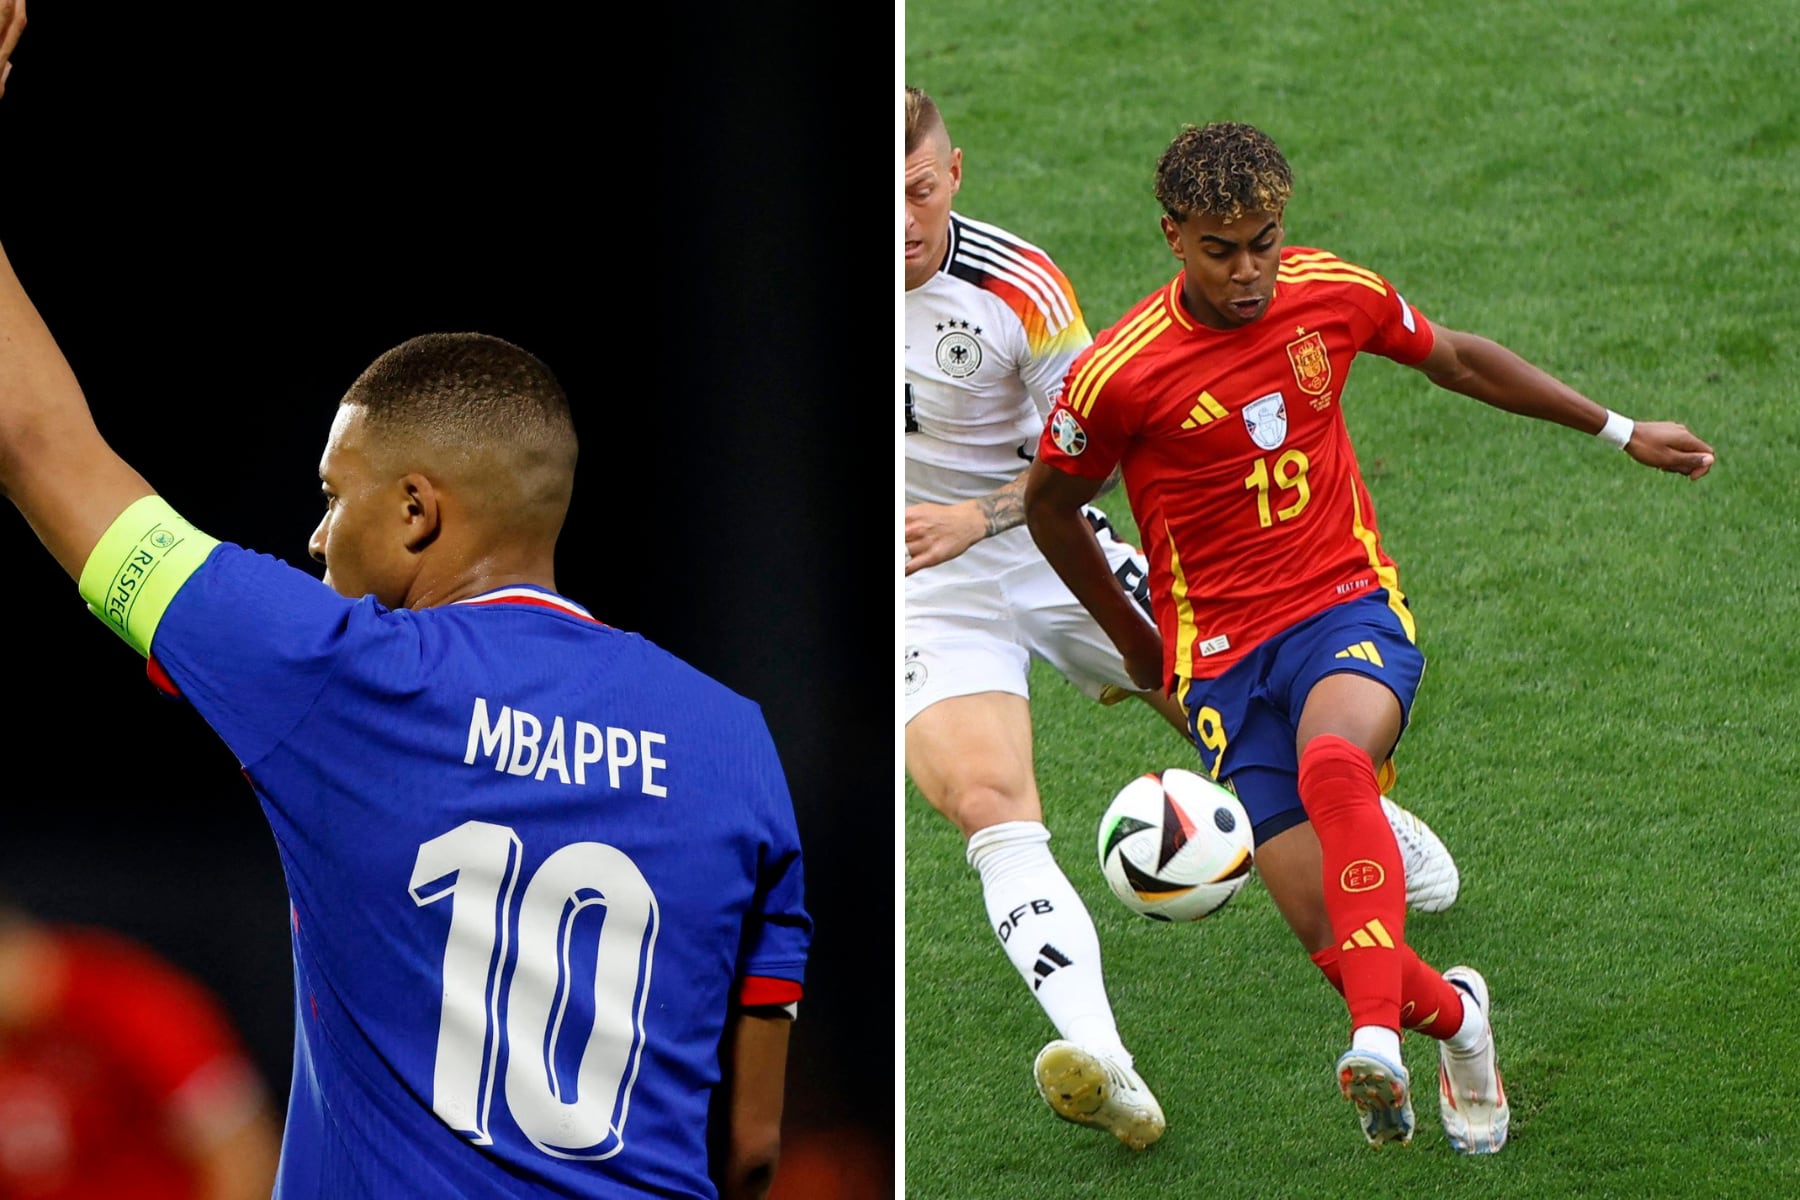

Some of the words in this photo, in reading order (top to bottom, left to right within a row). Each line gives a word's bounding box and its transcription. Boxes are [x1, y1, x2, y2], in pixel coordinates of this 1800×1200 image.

[1245, 449, 1311, 528] 19
[110, 550, 154, 632] RESPECT
[463, 697, 668, 798] MBAPPE
[998, 899, 1054, 943] DFB
[408, 820, 660, 1161] 10
